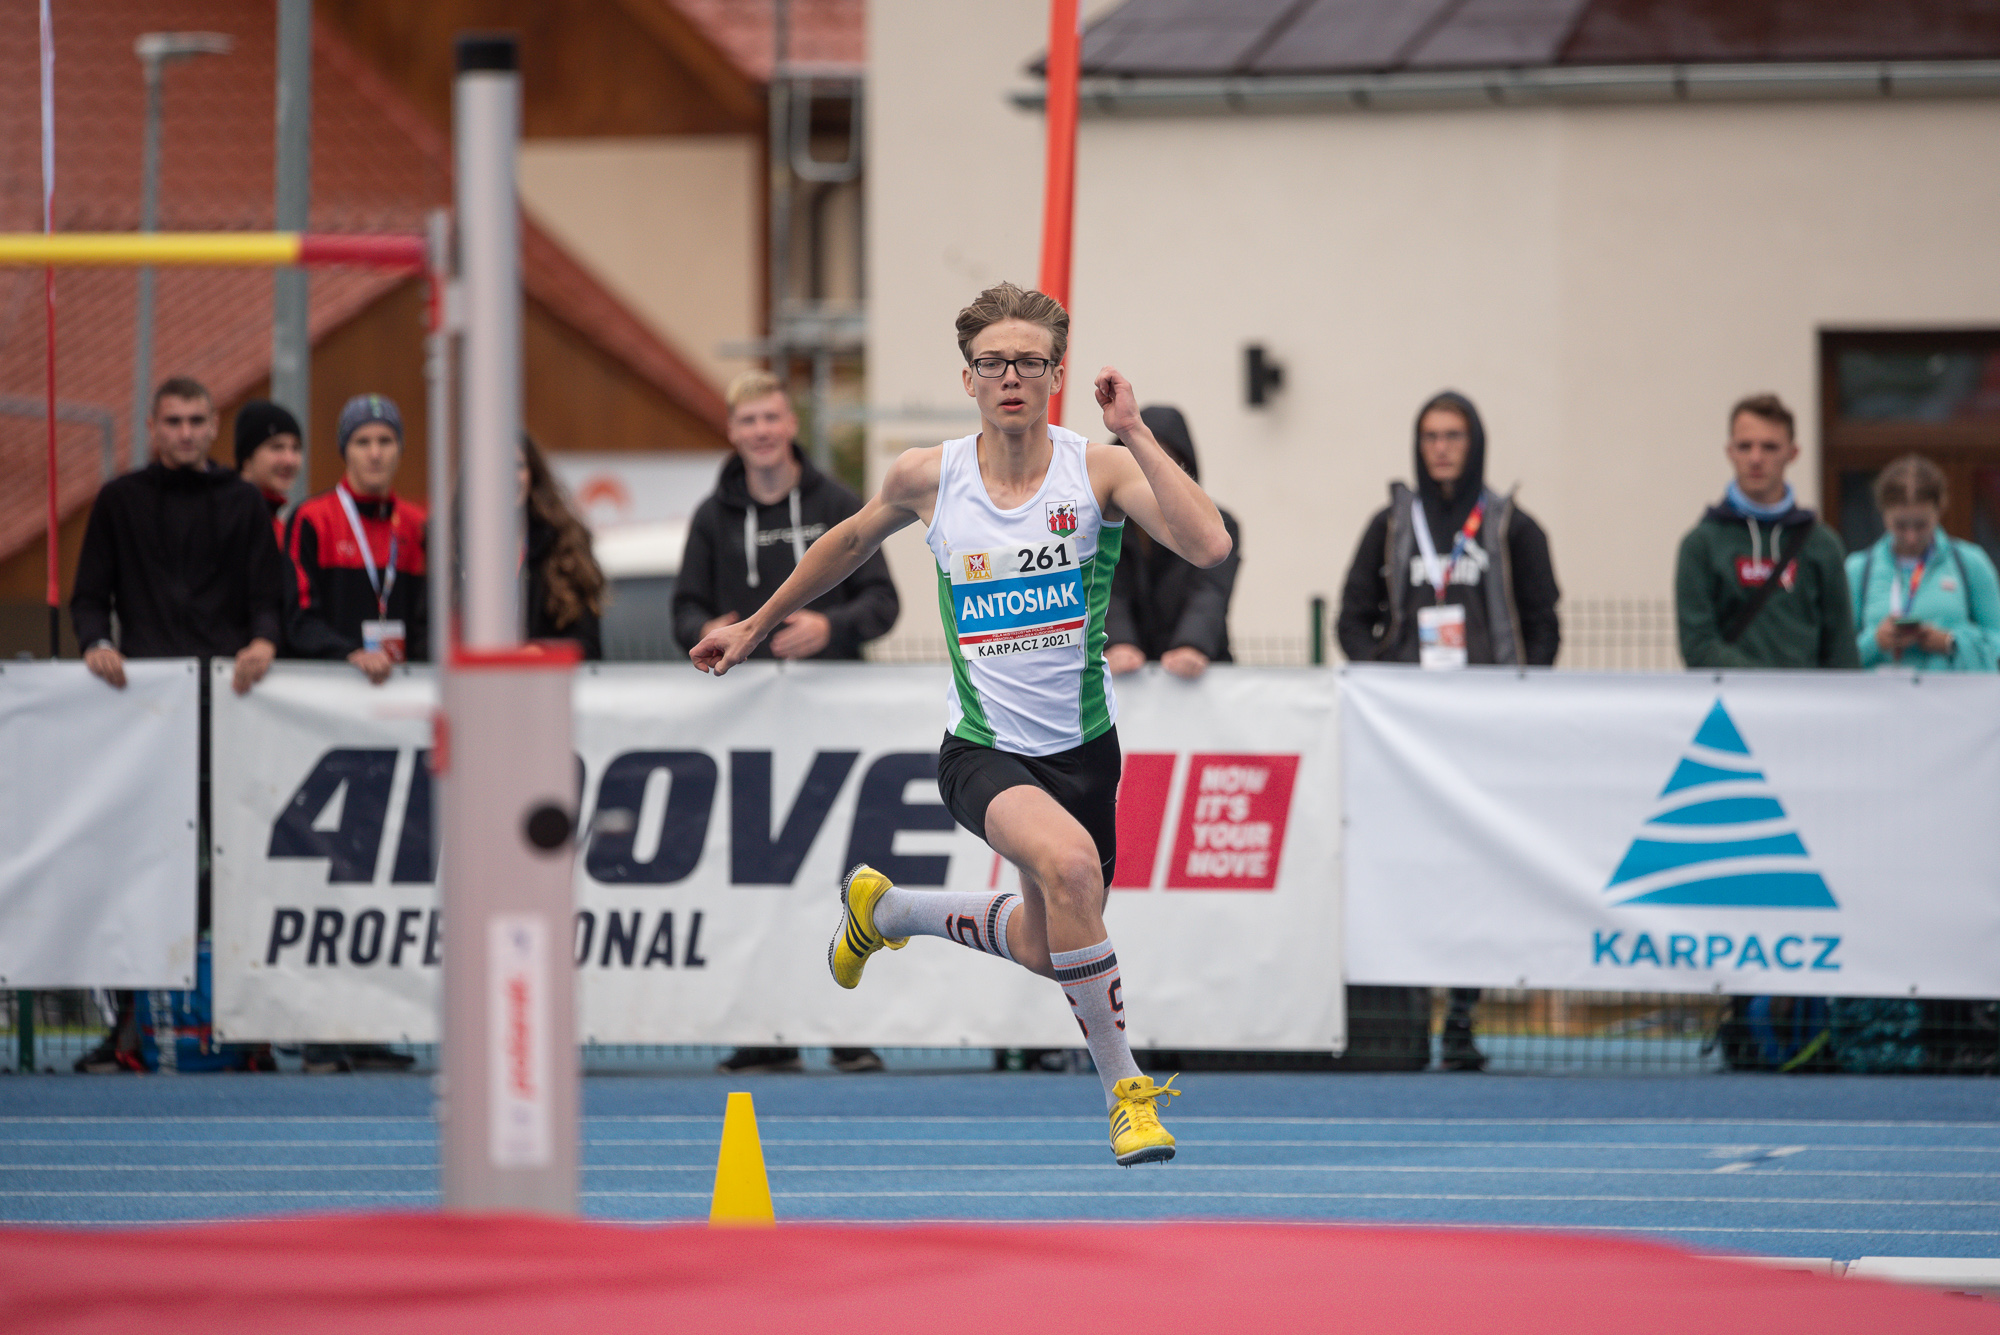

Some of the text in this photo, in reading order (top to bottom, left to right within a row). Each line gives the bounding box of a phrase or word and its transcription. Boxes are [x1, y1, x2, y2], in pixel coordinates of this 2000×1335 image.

[1018, 543, 1071, 573] 261
[961, 581, 1080, 621] ANTOSIAK
[978, 638, 1039, 657] KARPACZ
[1042, 633, 1071, 648] 2021
[1200, 764, 1270, 794] NOW
[266, 746, 958, 888] 4OVE
[1195, 794, 1250, 822] IT'S
[1192, 821, 1272, 851] YOUR
[1186, 850, 1270, 878] MOVE
[1592, 929, 1842, 972] KARPACZ
